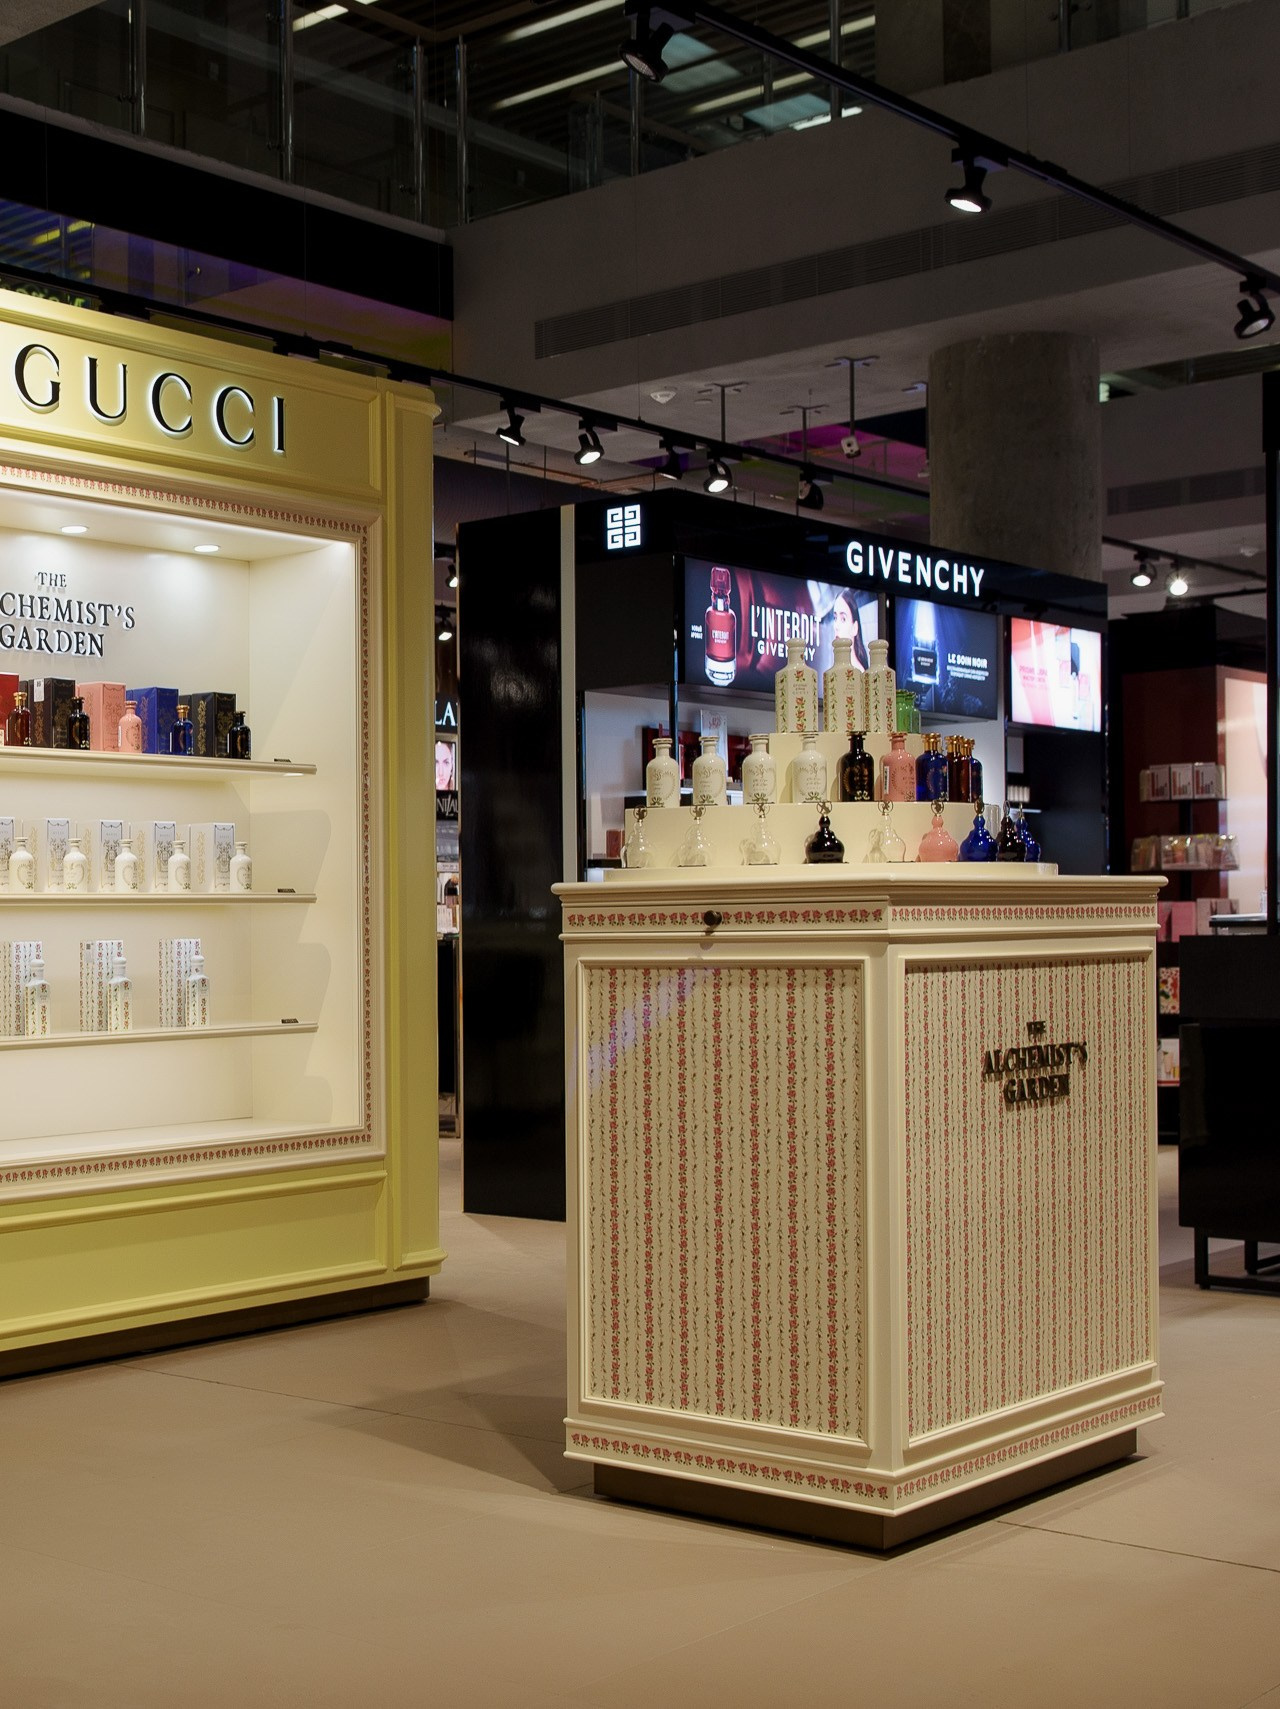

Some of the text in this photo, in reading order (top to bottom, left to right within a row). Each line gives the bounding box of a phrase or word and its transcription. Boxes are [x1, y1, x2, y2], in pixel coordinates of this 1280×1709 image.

[14, 344, 286, 453] GUCCI
[36, 571, 67, 588] THE
[846, 541, 985, 597] GIVENCHY
[751, 604, 822, 647] L'INTERDIT
[1003, 1074, 1070, 1103] GARDEN
